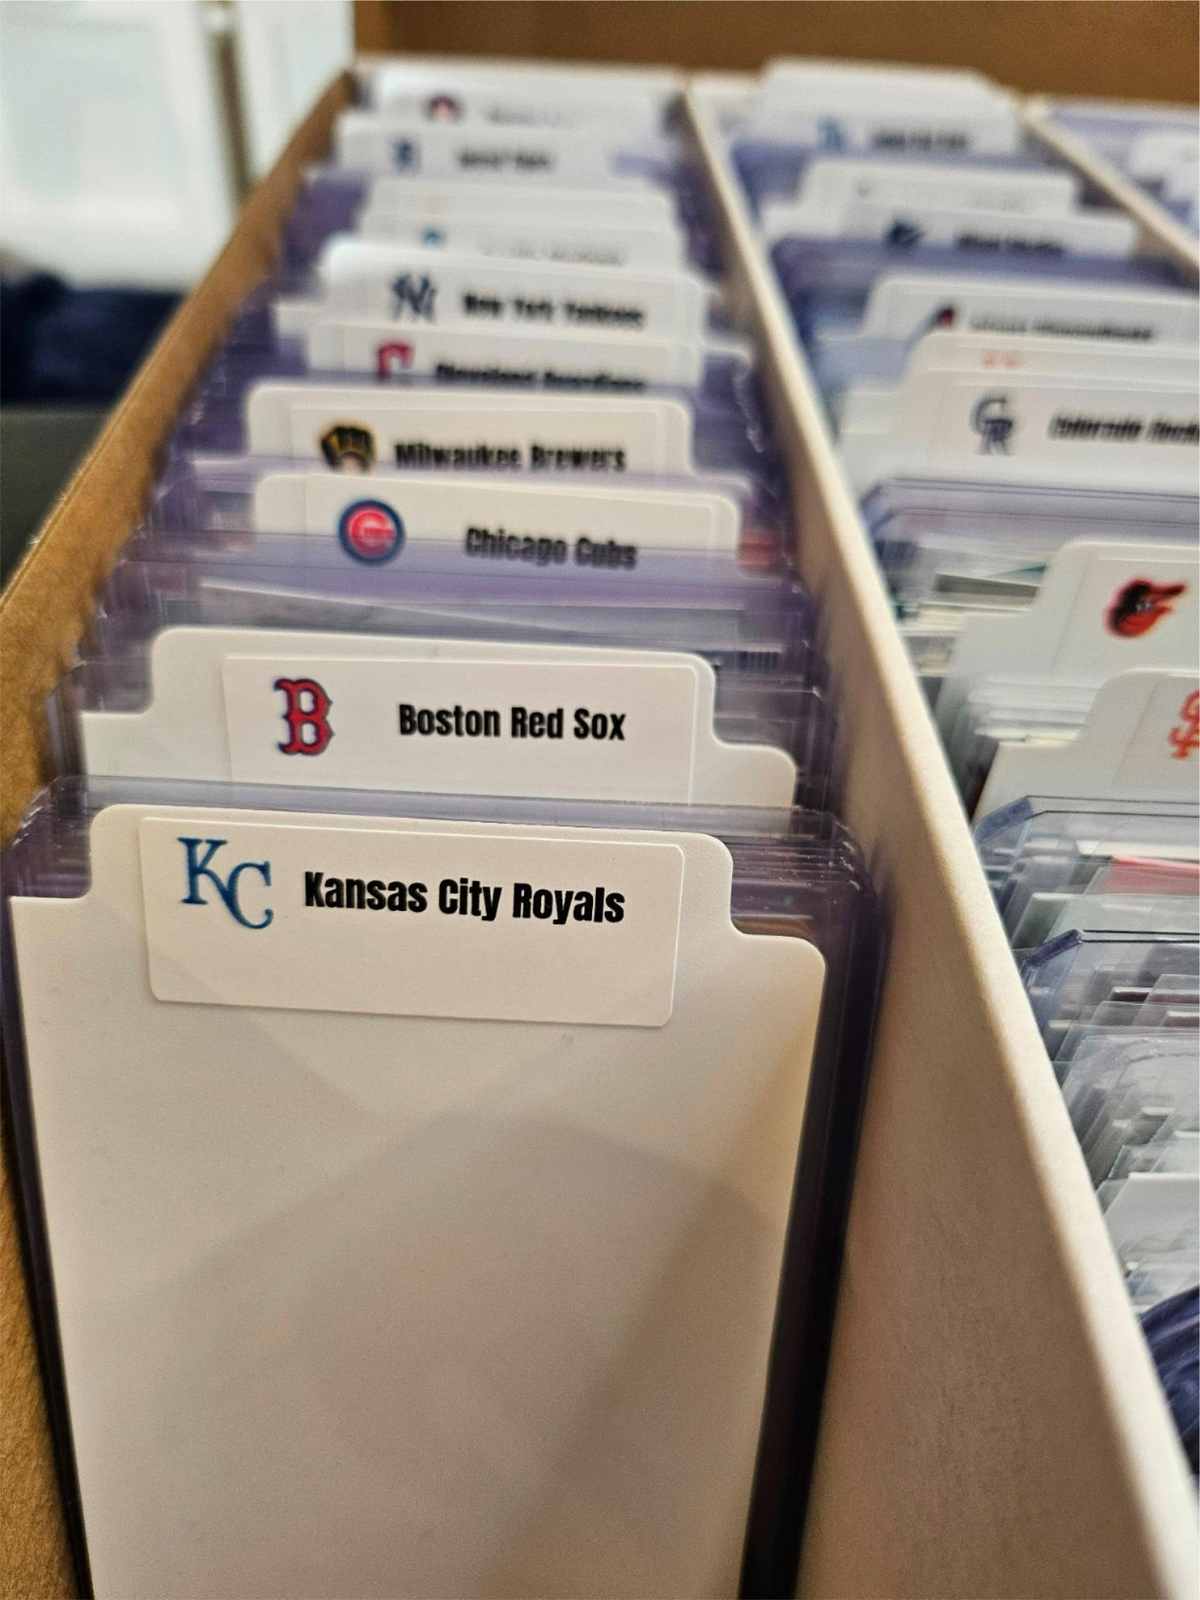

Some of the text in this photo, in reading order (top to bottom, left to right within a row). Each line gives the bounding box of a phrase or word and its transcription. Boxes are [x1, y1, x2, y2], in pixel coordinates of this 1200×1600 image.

[395, 440, 627, 472] Milwaukee Brewers
[464, 525, 638, 570] Chicago Cubs
[273, 677, 335, 757] B
[399, 703, 626, 741] Boston Red Sox
[176, 835, 275, 930] KC
[303, 871, 626, 926] Kansas City Royals
